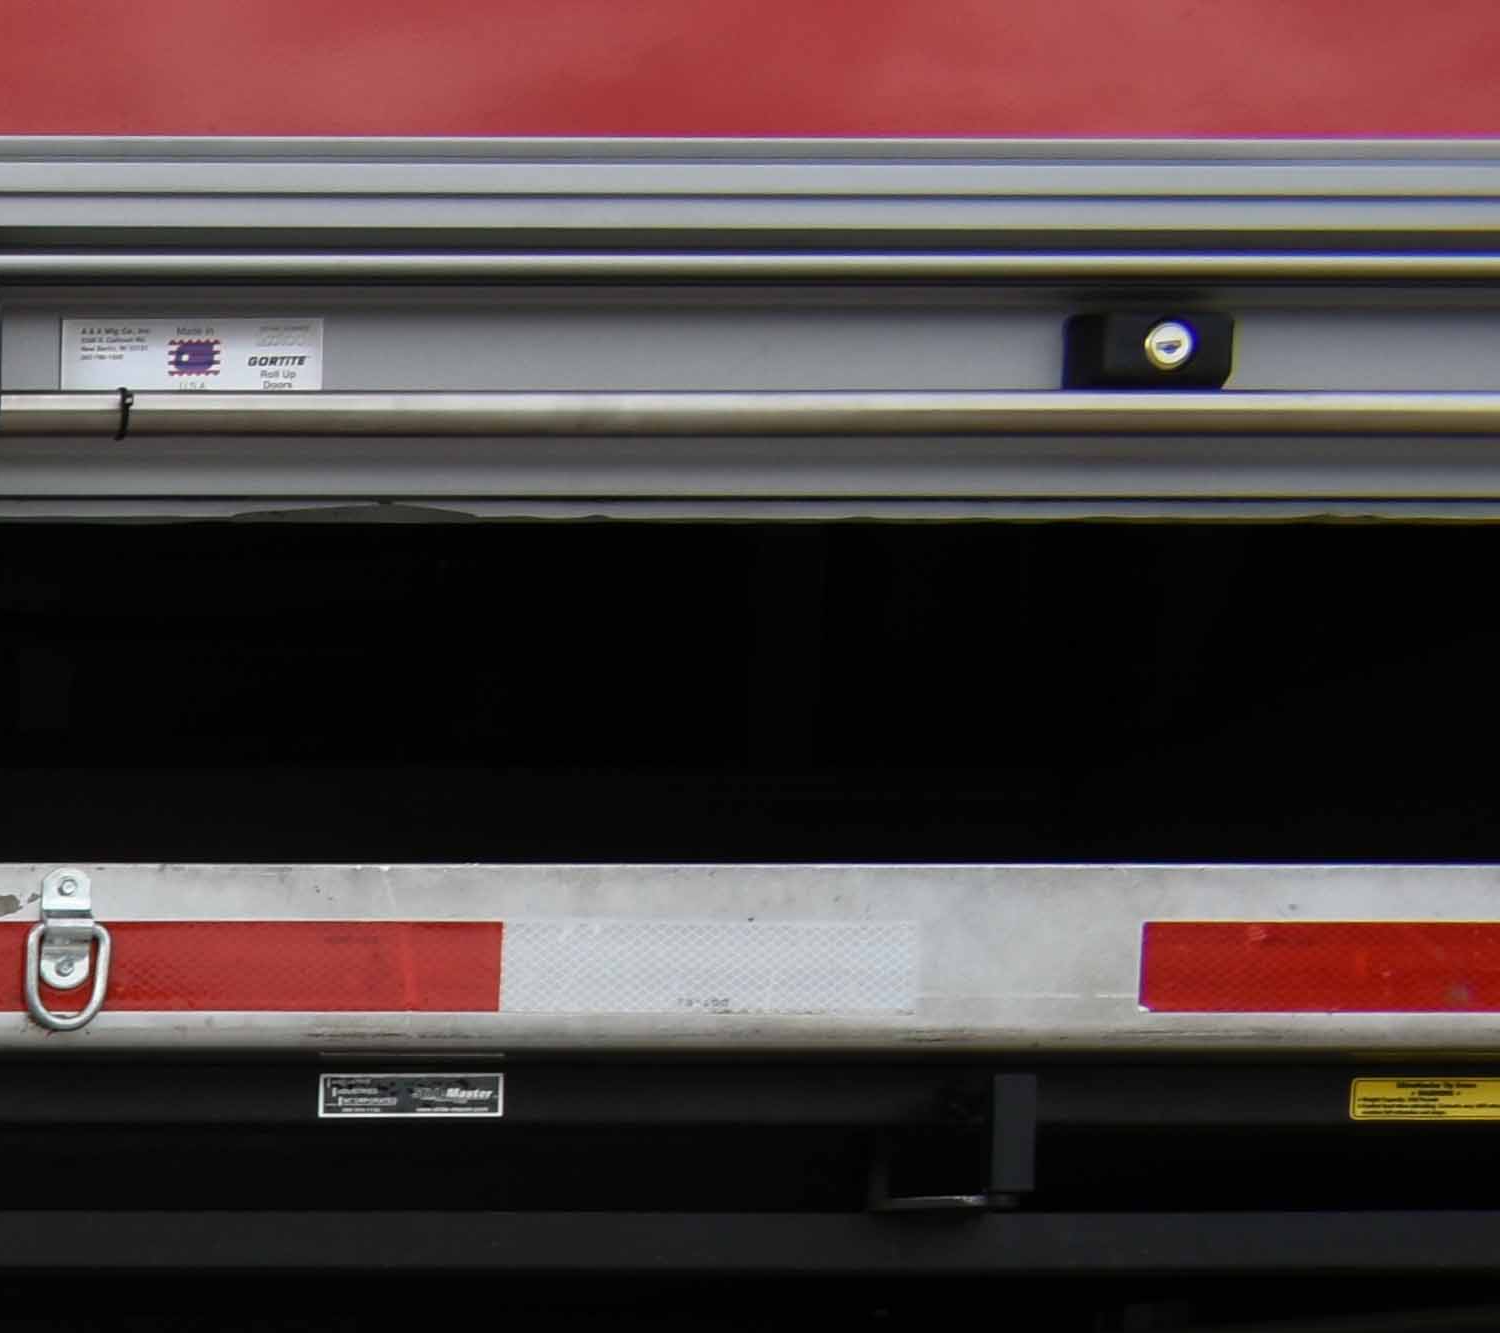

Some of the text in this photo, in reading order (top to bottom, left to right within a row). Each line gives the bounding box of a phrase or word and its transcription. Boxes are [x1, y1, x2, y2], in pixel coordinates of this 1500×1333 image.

[248, 355, 307, 366] GORTITE
[260, 370, 297, 380] Roll Up
